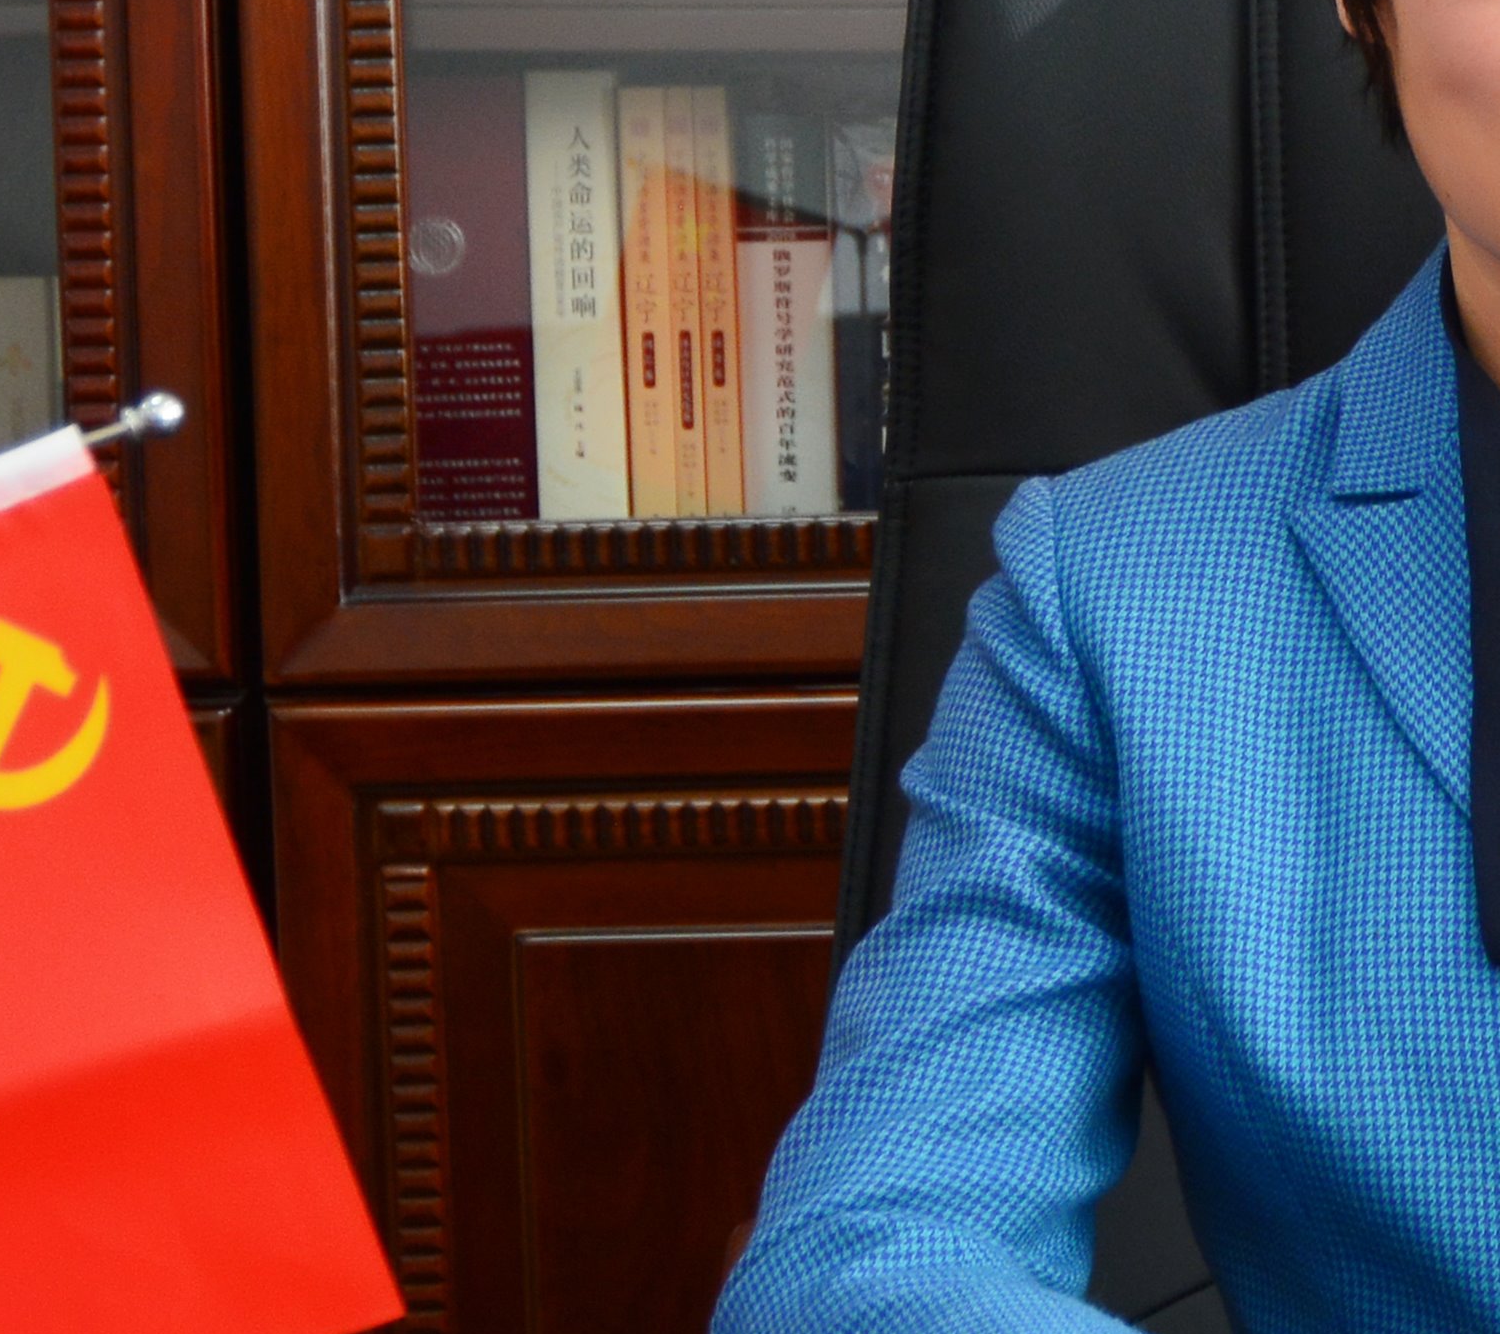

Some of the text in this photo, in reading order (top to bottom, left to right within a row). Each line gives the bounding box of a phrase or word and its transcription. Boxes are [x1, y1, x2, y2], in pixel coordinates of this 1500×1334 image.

[566, 124, 597, 318] 人类命运的回响
